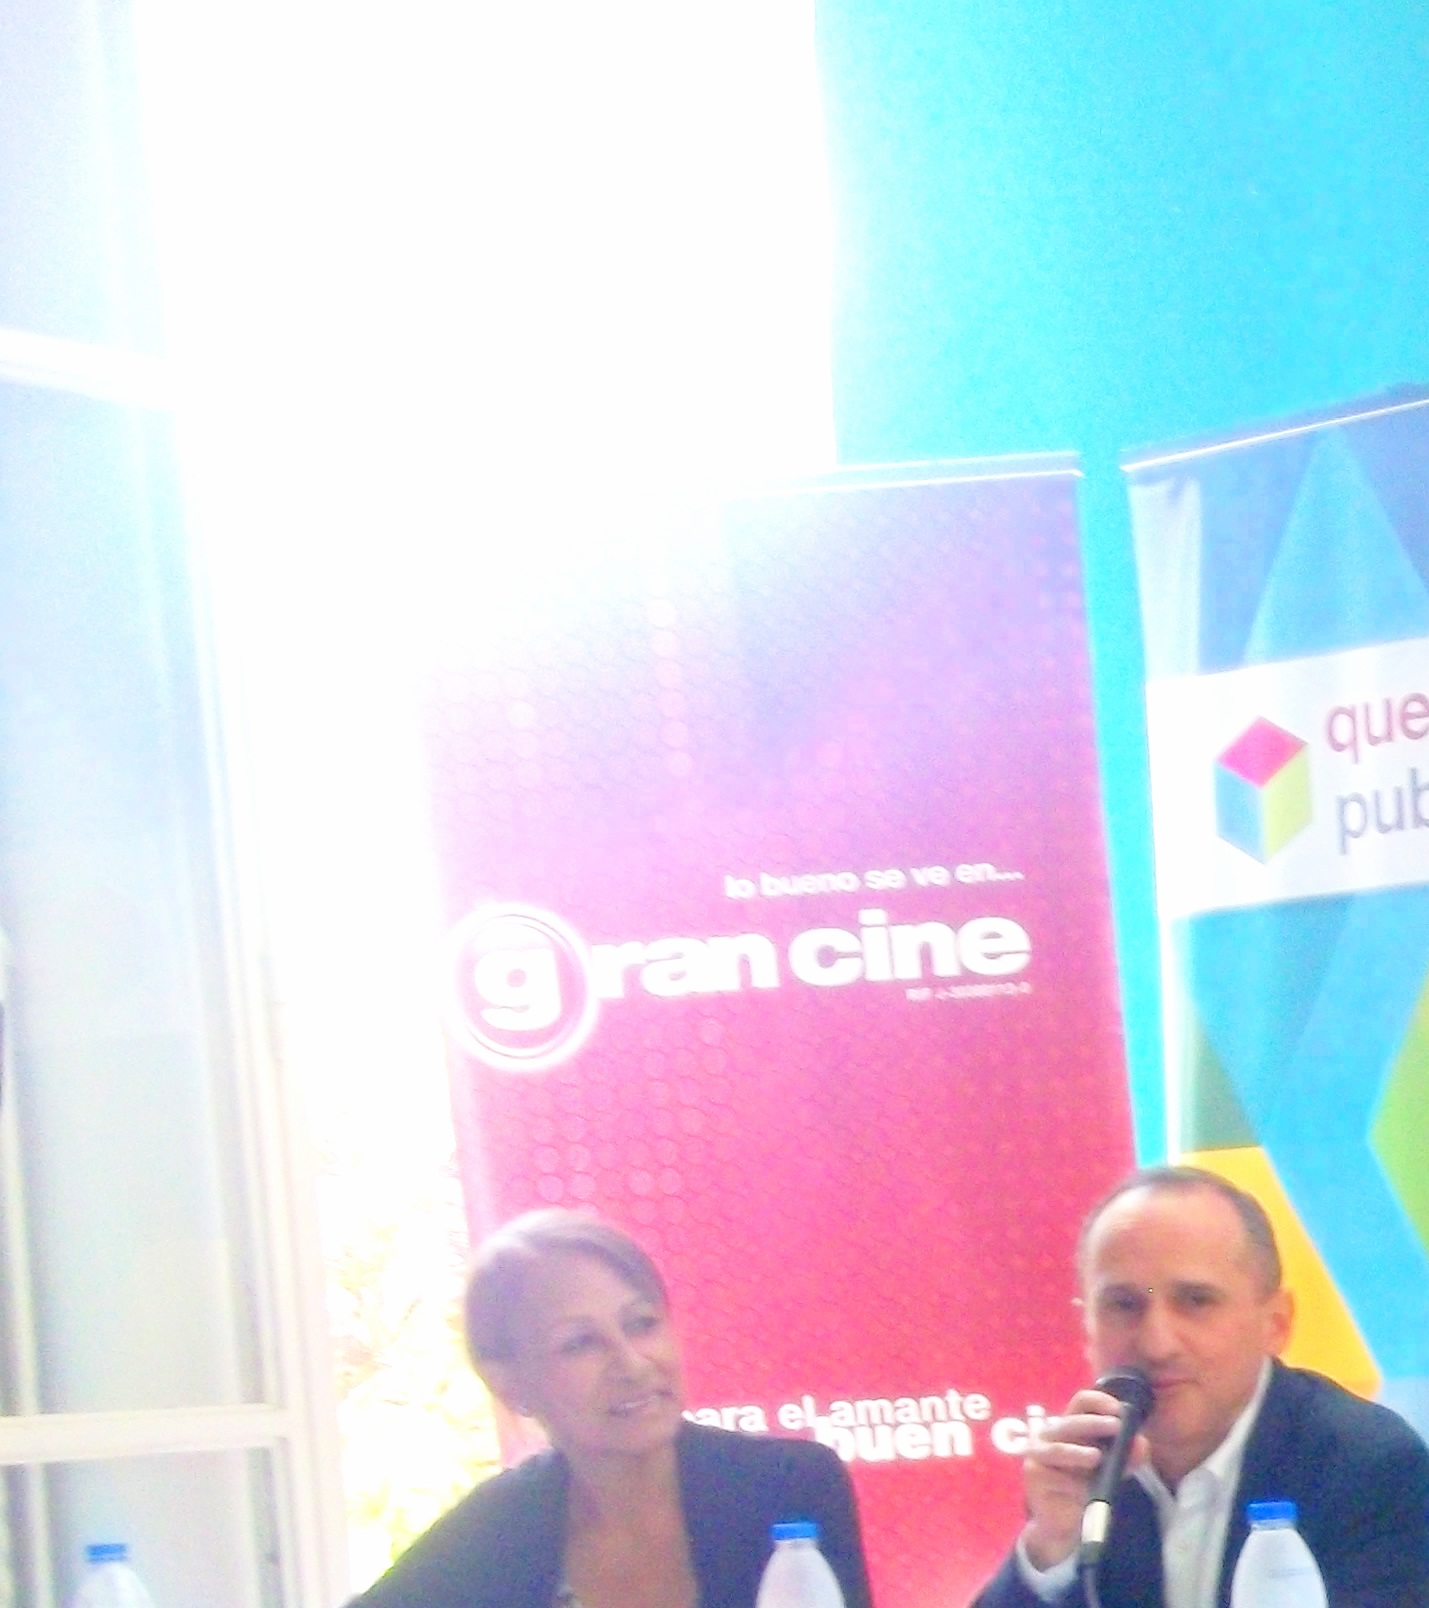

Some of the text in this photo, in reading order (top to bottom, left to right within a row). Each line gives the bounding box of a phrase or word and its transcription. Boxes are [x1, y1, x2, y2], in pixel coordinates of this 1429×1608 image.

[723, 874, 755, 899] lo
[760, 868, 859, 898] bueno
[864, 866, 904, 891] se
[909, 862, 949, 887] ve
[473, 908, 1031, 1031] gran cine
[681, 1389, 991, 1433] ara el amante
[814, 1405, 1066, 1462] buen ci
